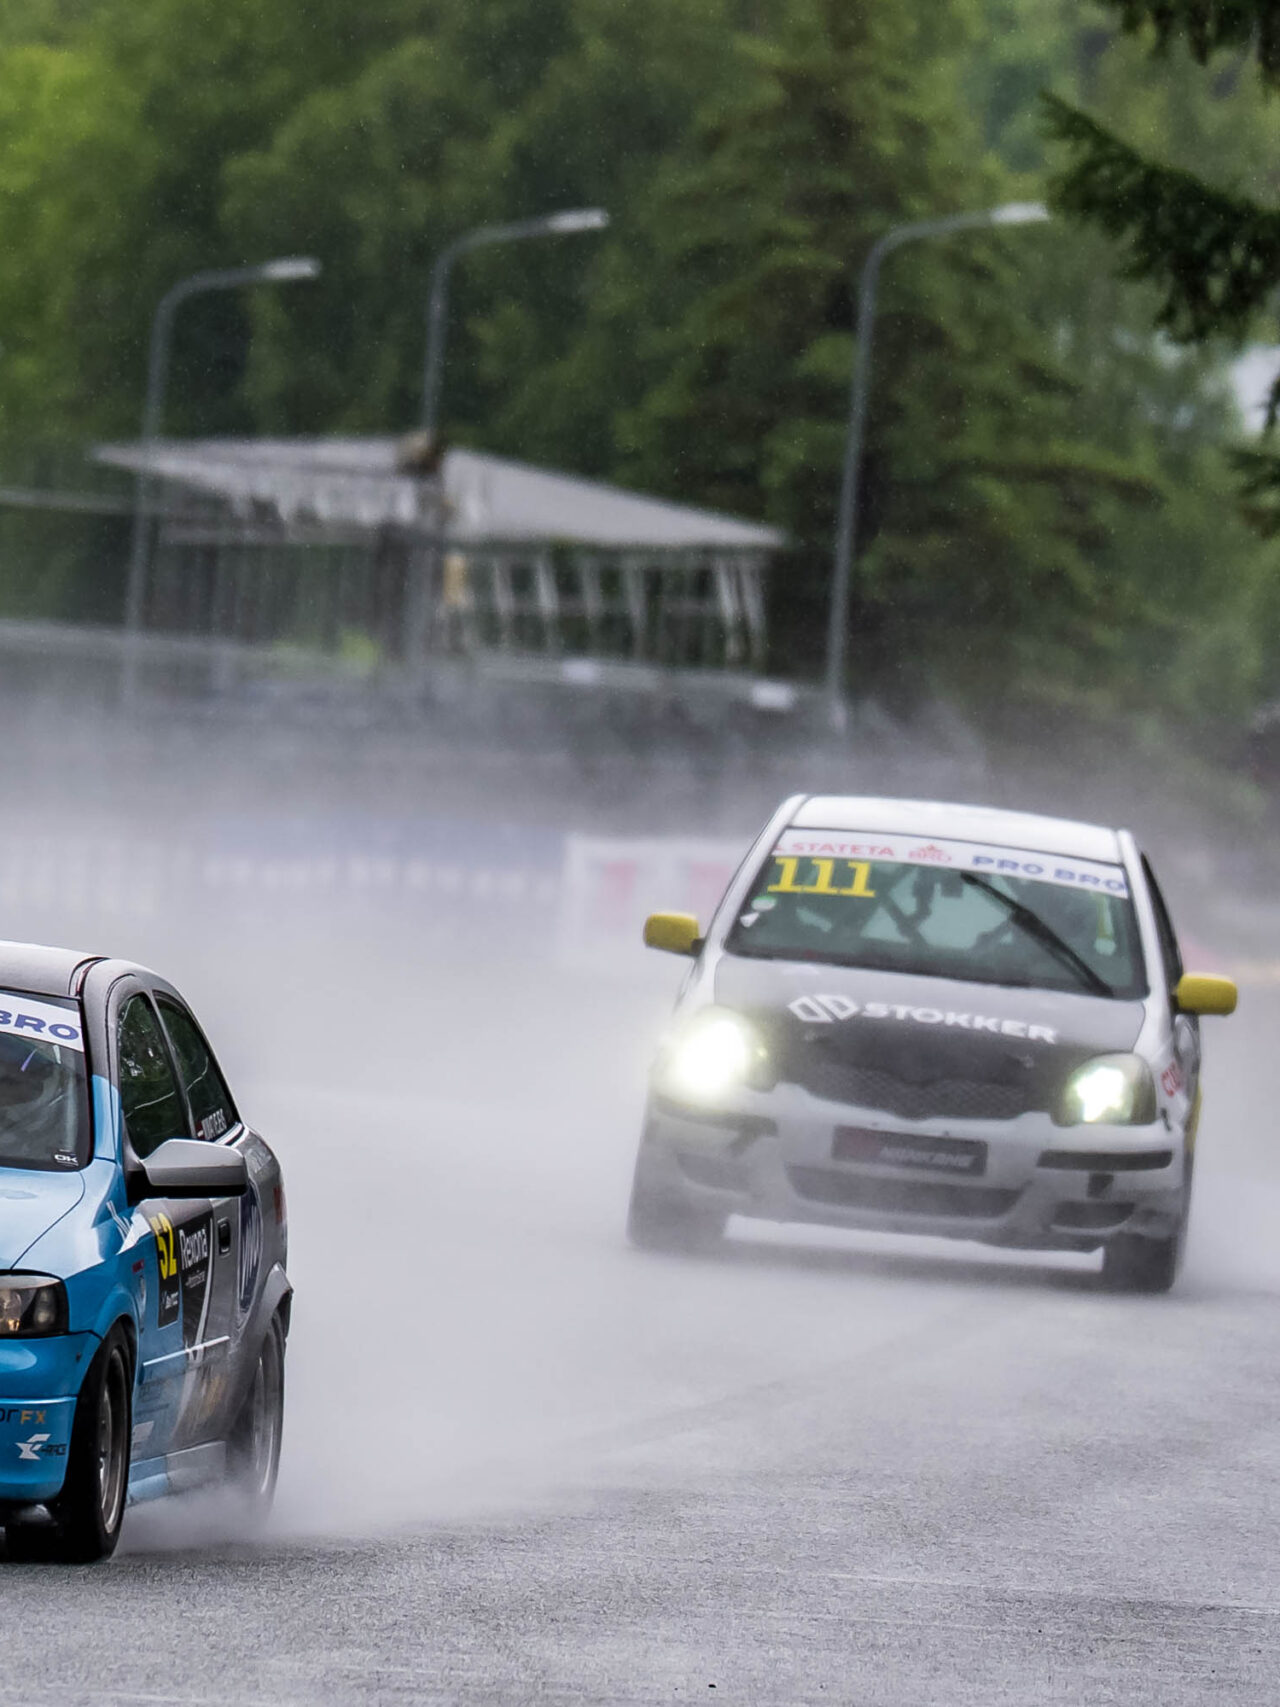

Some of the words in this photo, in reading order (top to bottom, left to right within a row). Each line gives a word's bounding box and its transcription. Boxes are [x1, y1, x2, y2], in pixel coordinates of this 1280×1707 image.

[767, 856, 875, 898] 111
[972, 855, 1044, 875] PRO
[1054, 868, 1126, 891] BRO
[862, 1002, 1057, 1044] STOKKER
[148, 1212, 177, 1280] 52
